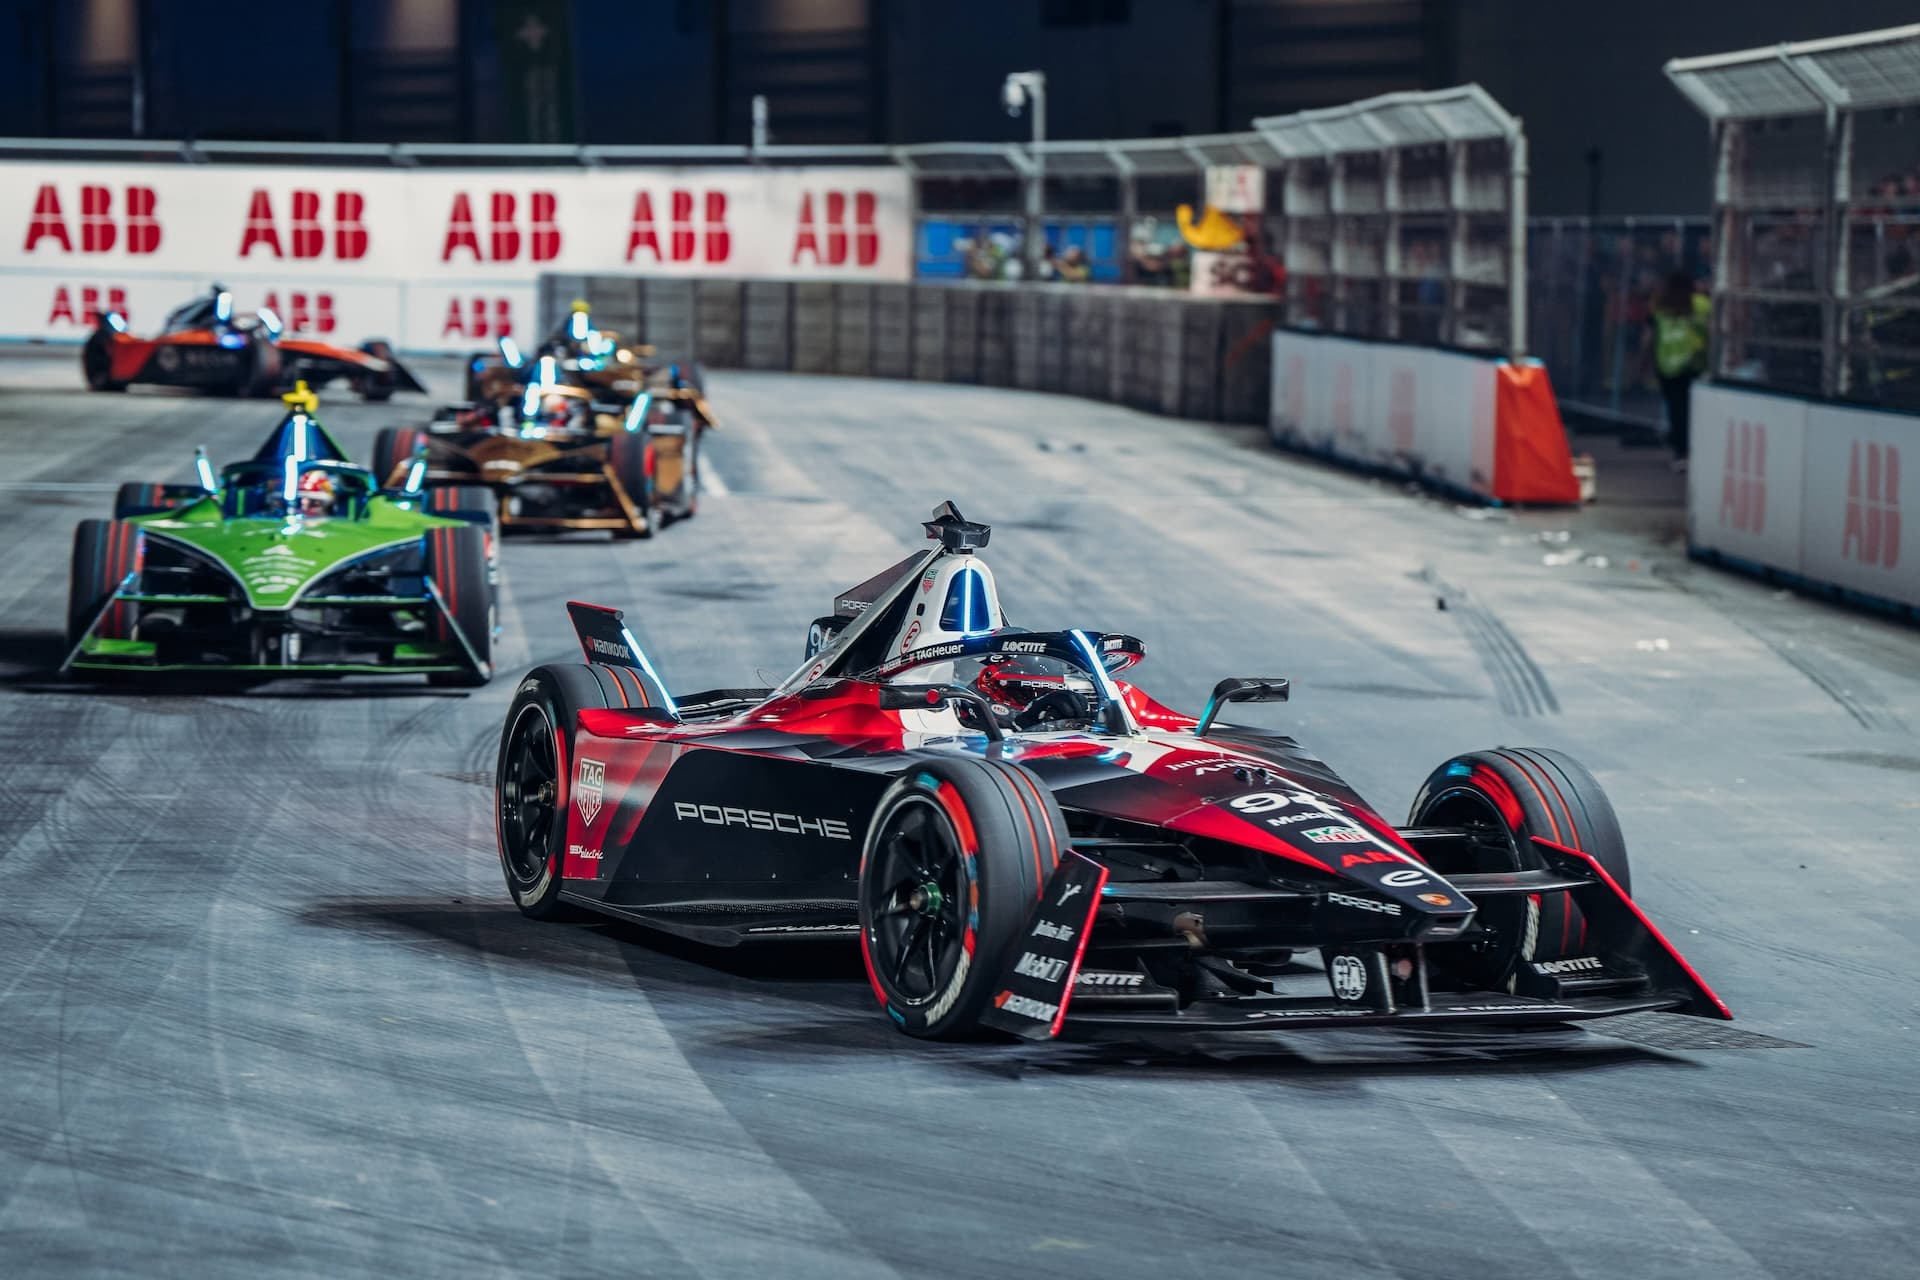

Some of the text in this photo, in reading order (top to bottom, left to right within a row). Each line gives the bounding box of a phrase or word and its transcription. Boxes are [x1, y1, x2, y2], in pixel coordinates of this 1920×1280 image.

[25, 184, 162, 255] ABB
[239, 189, 369, 261] ABB
[442, 191, 562, 263] ABB
[627, 190, 733, 265] ABB
[794, 191, 881, 267] ABB
[49, 285, 128, 327] ABB
[445, 299, 512, 338] ABB
[1841, 438, 1901, 569] ABB
[1001, 641, 1047, 653] LOCTITE
[582, 764, 602, 786] TAG
[578, 786, 601, 820] HEUER
[673, 801, 852, 840] PORSCHE
[1327, 891, 1402, 916] PORSCHE
[1533, 957, 1604, 975] LOCTITE
